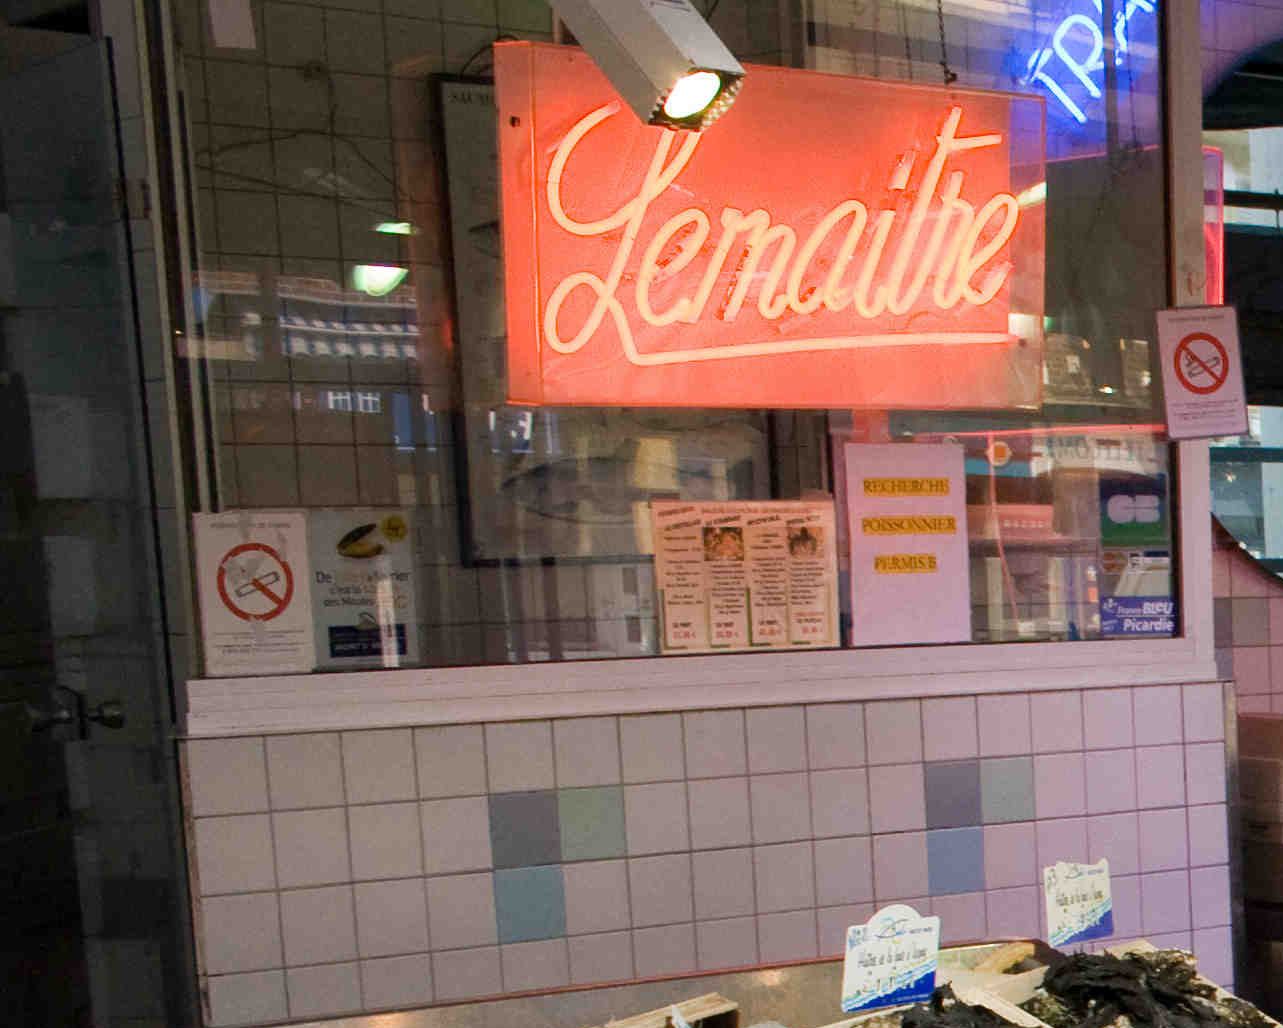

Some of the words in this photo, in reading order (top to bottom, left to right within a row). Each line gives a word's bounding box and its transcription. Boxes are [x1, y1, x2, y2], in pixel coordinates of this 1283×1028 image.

[863, 479, 950, 494] RECHERCHE
[861, 518, 956, 533] POISSONNIER
[874, 557, 926, 572] PERMIS
[927, 556, 937, 569] B
[1122, 617, 1175, 633] Picardie
